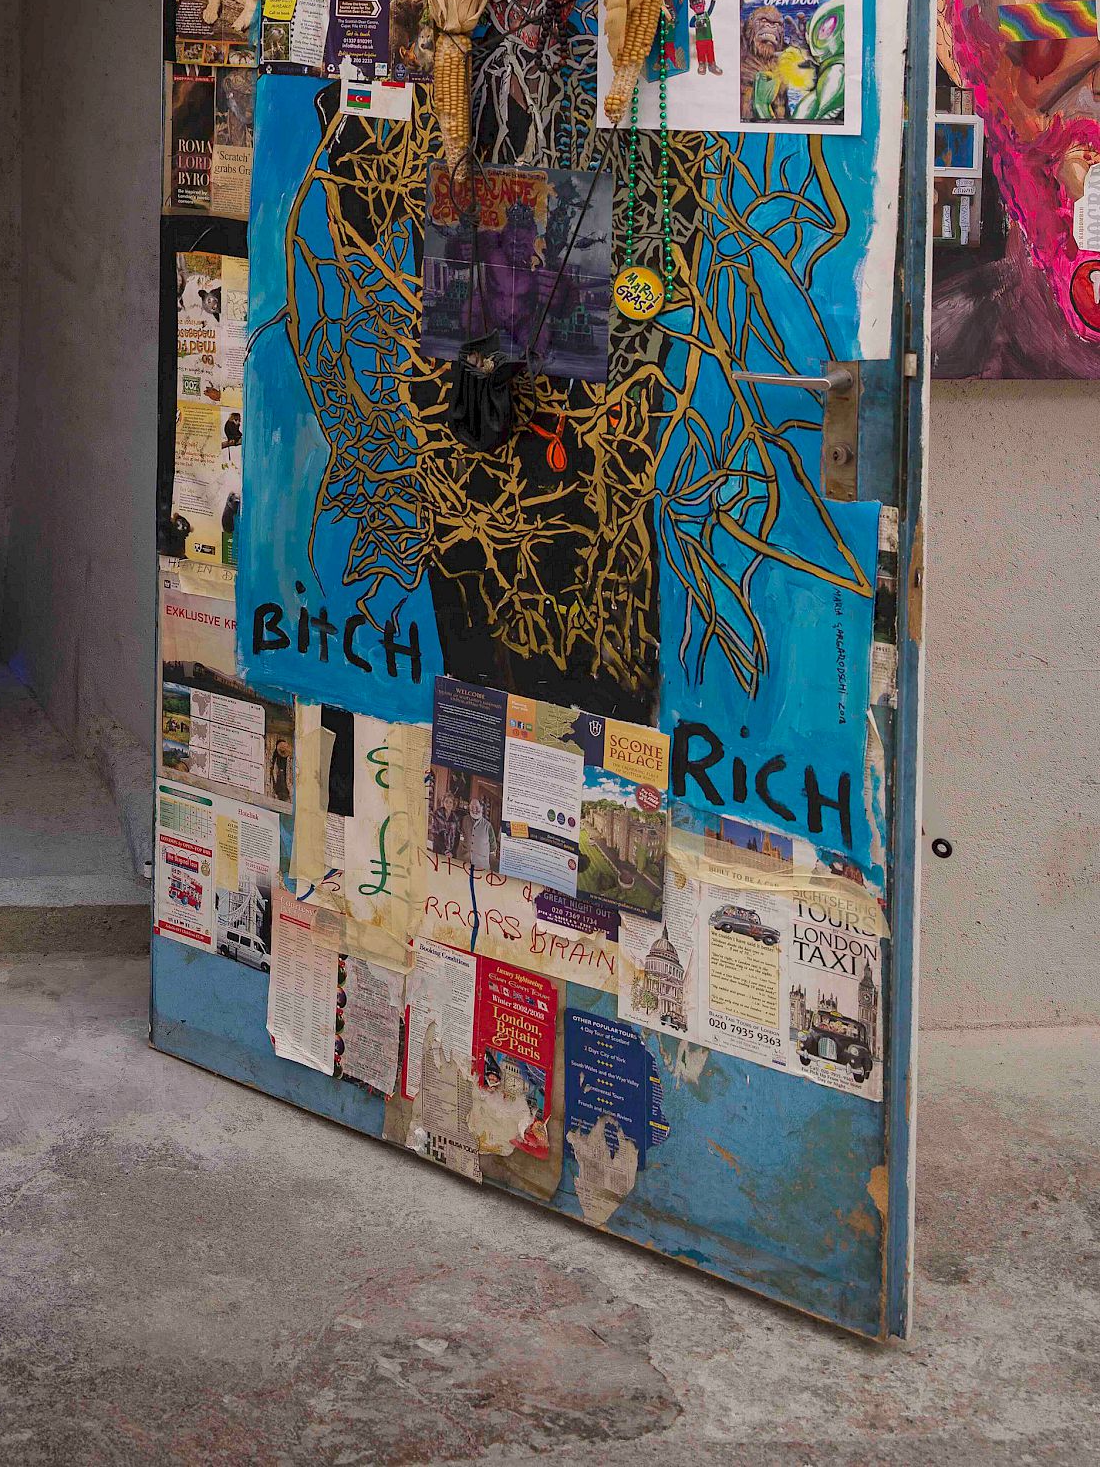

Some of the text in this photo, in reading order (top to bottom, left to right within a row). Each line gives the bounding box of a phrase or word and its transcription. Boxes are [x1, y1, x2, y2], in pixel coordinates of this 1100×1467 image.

[177, 154, 212, 170] LORD
[214, 164, 237, 176] grabs
[177, 171, 210, 186] BYRO
[616, 284, 655, 314] GRAS!
[166, 605, 221, 627] EXKLUSIVE
[455, 687, 485, 699] WELCOME
[609, 734, 664, 760] SCONE
[609, 746, 664, 772] PALACE
[732, 872, 743, 881] TO
[744, 875, 755, 883] BE
[543, 893, 612, 919] GREAT NIGHT OUT
[551, 906, 598, 925] 020 7369 1734
[792, 896, 877, 938] TOURS
[529, 922, 616, 976] BRAIN
[793, 923, 878, 962] LONDON
[419, 943, 470, 968] Booking Conditions
[792, 939, 857, 976] TAXI
[496, 966, 514, 980] Luxury
[492, 994, 545, 1021] Winter 2002/2003
[492, 1005, 543, 1039] London,
[496, 1020, 538, 1047] Britain
[572, 1015, 638, 1040] OTHER POPULAR TOURS
[708, 1010, 780, 1036] BLACK TOURS LONDON
[708, 1017, 727, 1031] 020
[730, 1023, 755, 1039] 7935
[757, 1032, 782, 1047] 9363
[492, 1032, 541, 1061] & Paris
[594, 1028, 630, 1046] Tour Scotland
[571, 1059, 584, 1069] South
[584, 1064, 598, 1074] Wales
[577, 1099, 602, 1112] French and
[612, 1091, 625, 1102] Tours
